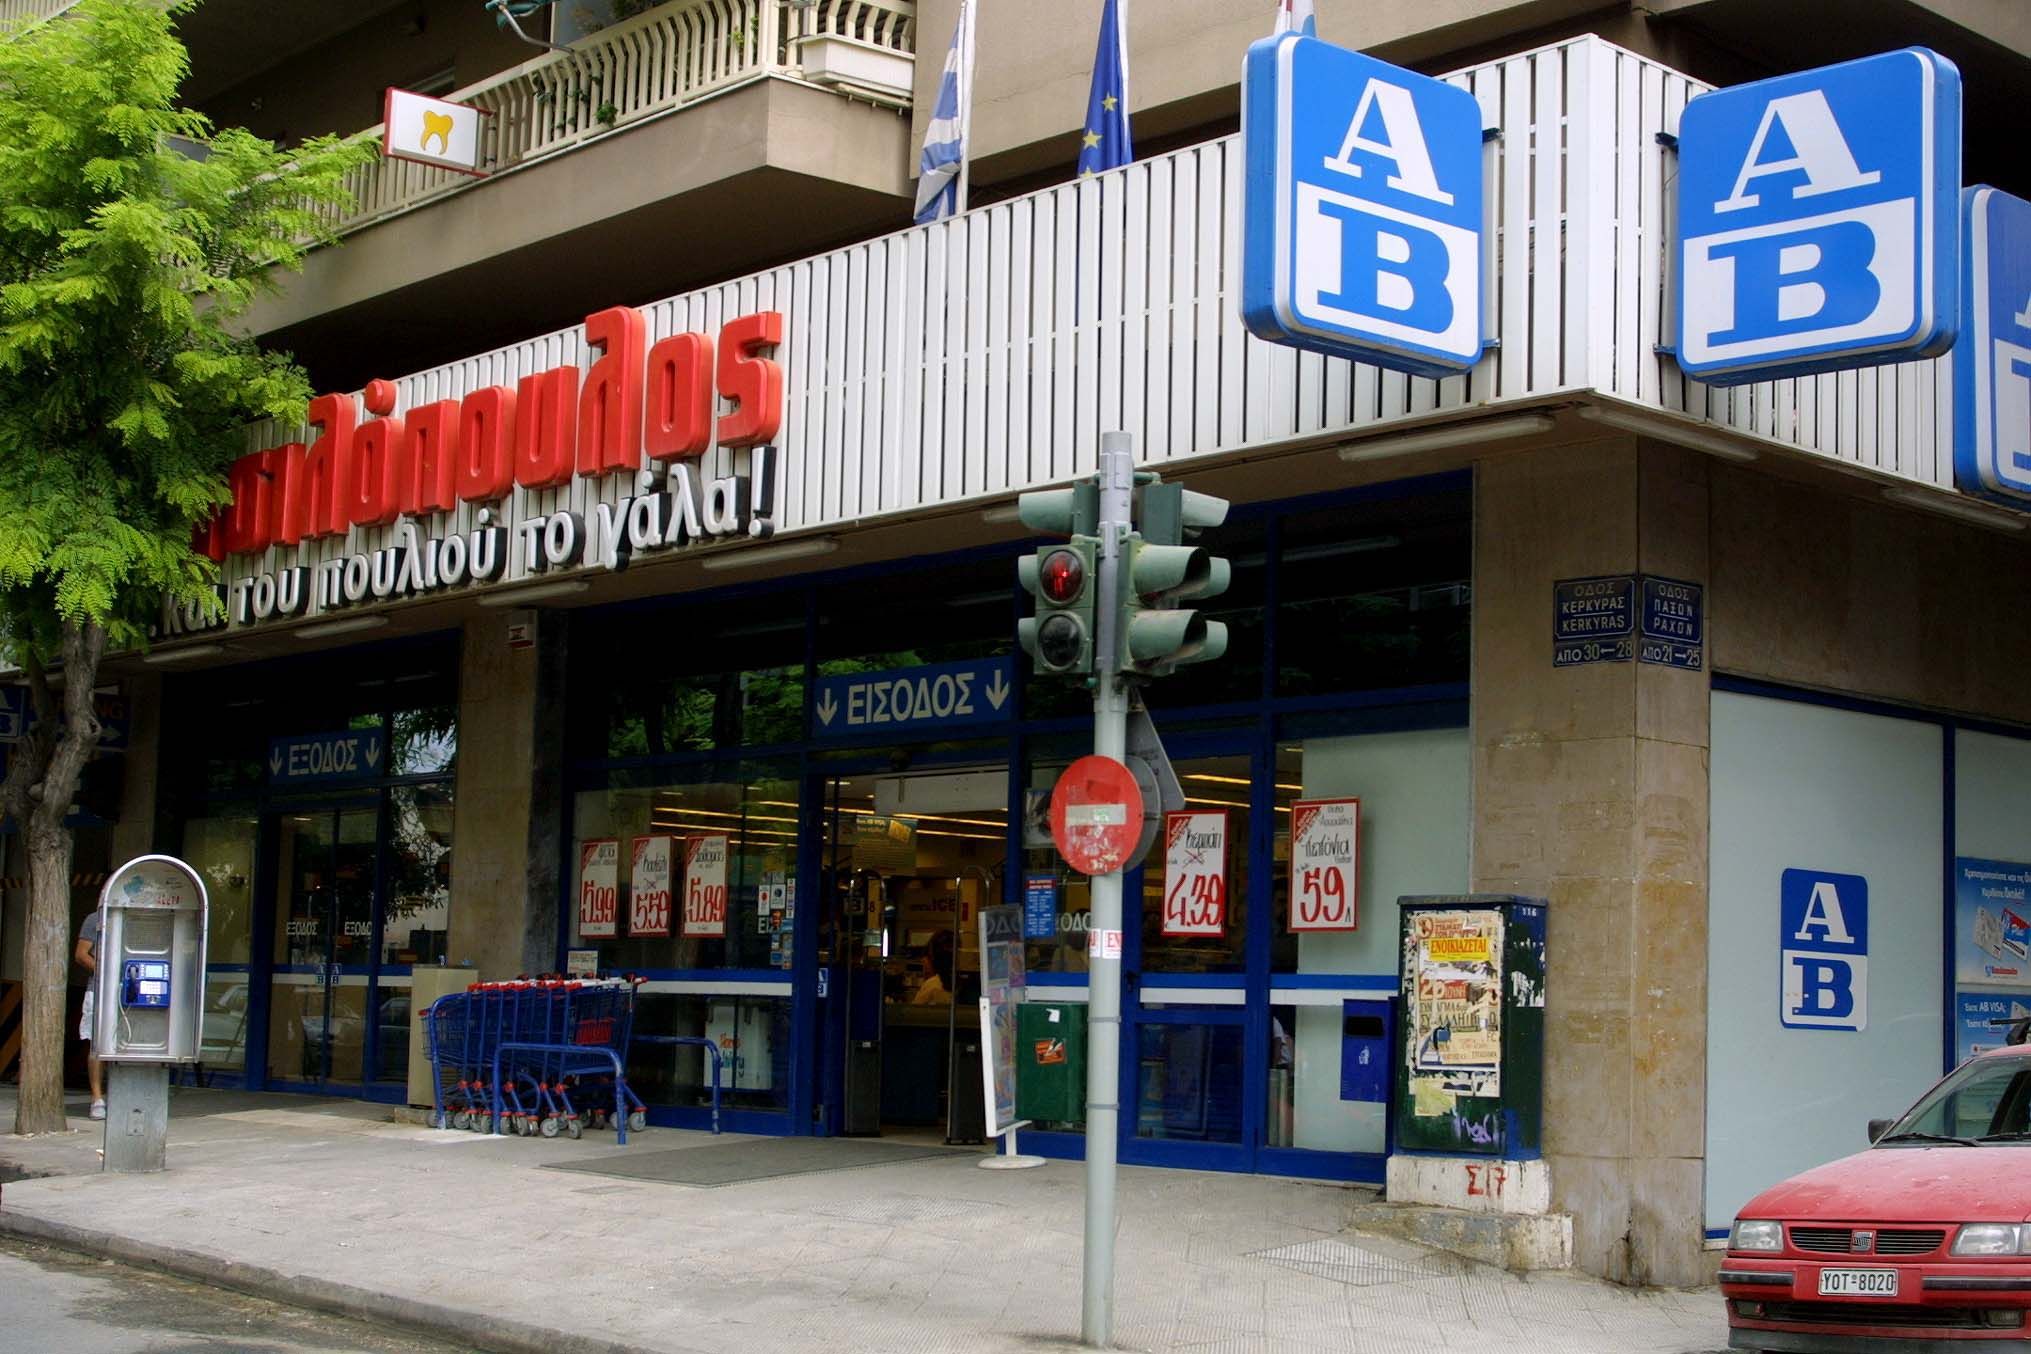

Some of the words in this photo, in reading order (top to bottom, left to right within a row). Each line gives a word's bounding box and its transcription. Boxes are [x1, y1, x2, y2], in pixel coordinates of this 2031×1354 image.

[235, 566, 305, 625] του
[319, 508, 502, 609] πουλιού
[520, 510, 585, 572] το
[598, 445, 776, 571] γάλα!
[1574, 582, 1615, 597] ΟΔΟΣ
[1658, 584, 1689, 601] ΟΔΟΣ
[1562, 597, 1625, 614] ΚΕΡΚΥΡΑΣ
[1562, 615, 1625, 632] KERKYRAS
[1653, 618, 1693, 637] PAXON
[1556, 648, 1582, 663] ΑΠΟ
[1583, 644, 1600, 661] 30
[1616, 641, 1633, 658] 28
[1642, 647, 1662, 660] ΑΠΟ
[846, 672, 975, 725] ΕΙΣΟΔΟΣ
[288, 739, 358, 776] ΕΞΟΔΟΣ
[1300, 866, 1345, 922] 59
[1431, 939, 1487, 954] ΕΝΟΙΚΙΑΖΕΤΑΙ
